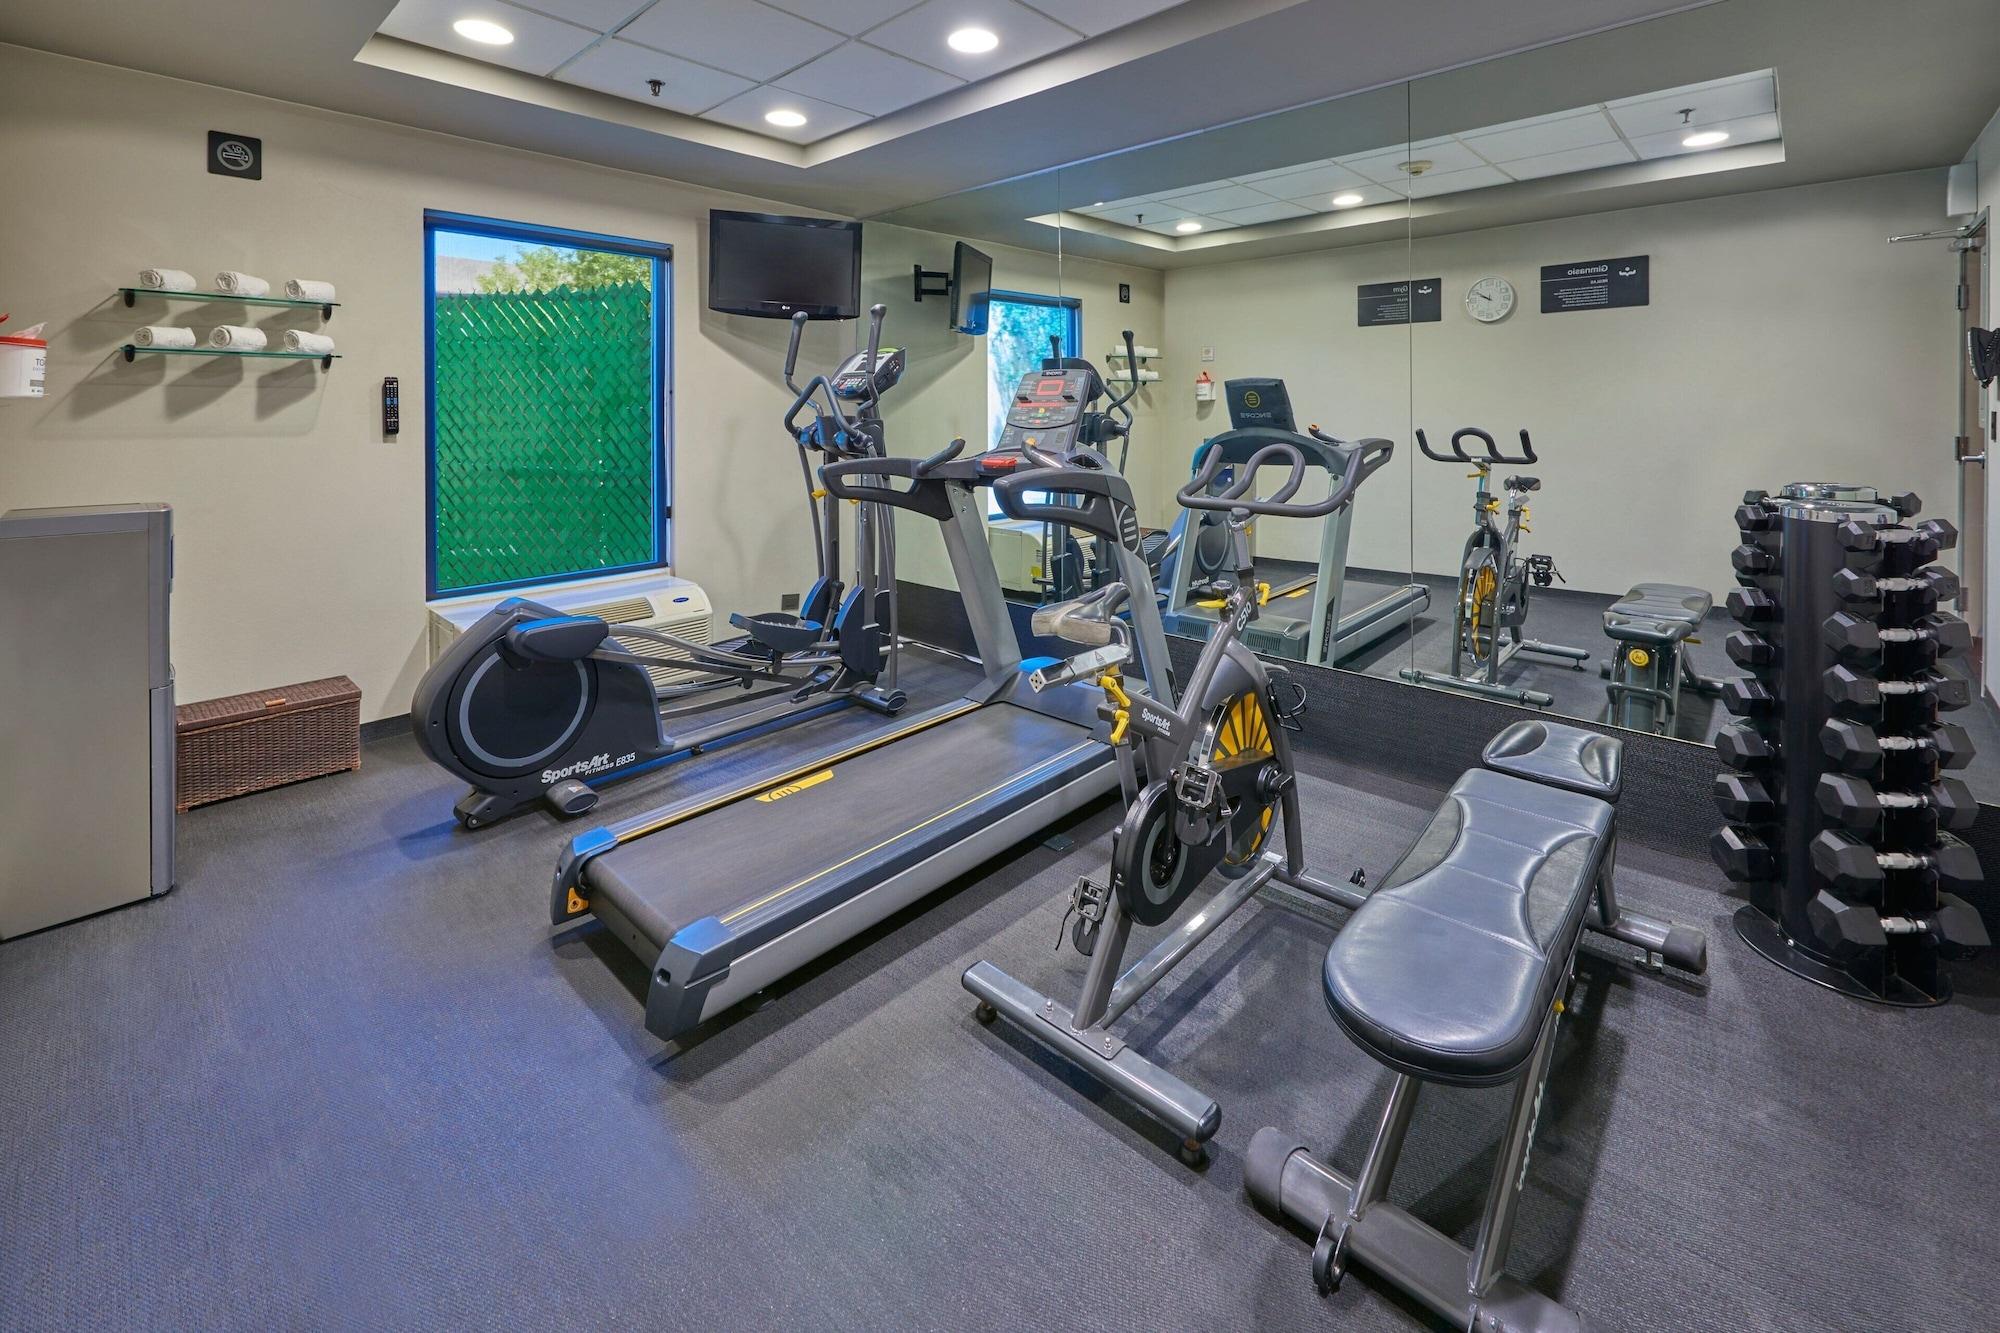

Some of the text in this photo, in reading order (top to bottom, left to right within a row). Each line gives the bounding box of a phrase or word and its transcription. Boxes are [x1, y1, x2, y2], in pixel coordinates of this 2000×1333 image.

[1236, 601, 1252, 632] C510
[1141, 708, 1171, 731] SportsArt
[541, 752, 636, 784] SportsArt E835
[584, 761, 614, 776] FITNESS
